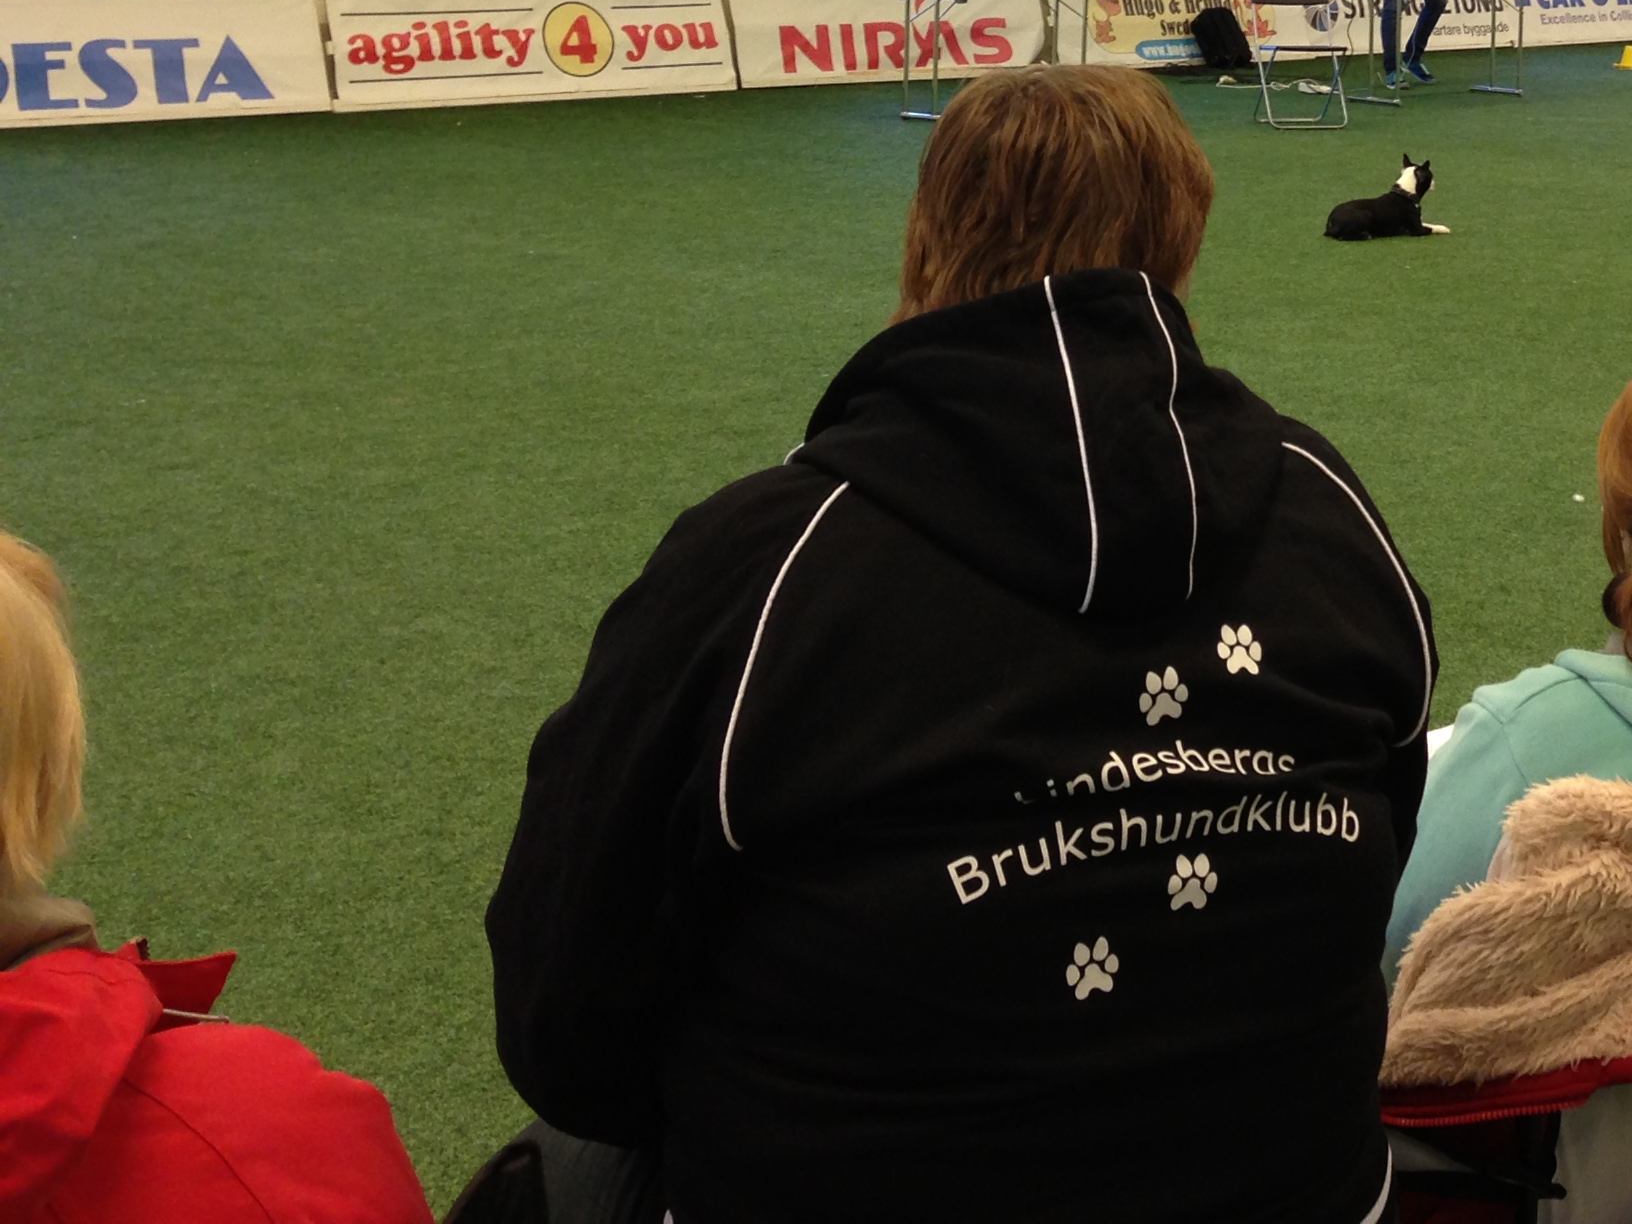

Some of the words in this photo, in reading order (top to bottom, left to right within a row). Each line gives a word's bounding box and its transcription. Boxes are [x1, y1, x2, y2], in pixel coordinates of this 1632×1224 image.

[347, 19, 535, 75] agility
[559, 14, 599, 64] 4
[621, 21, 719, 63] you
[779, 17, 1013, 74] NIRAS
[1160, 19, 1194, 37] Swed
[1540, 12, 1597, 26] Excellence
[1598, 11, 1606, 22] in
[0, 33, 275, 112] ESTA
[947, 790, 1360, 905] Brukshundklubb
